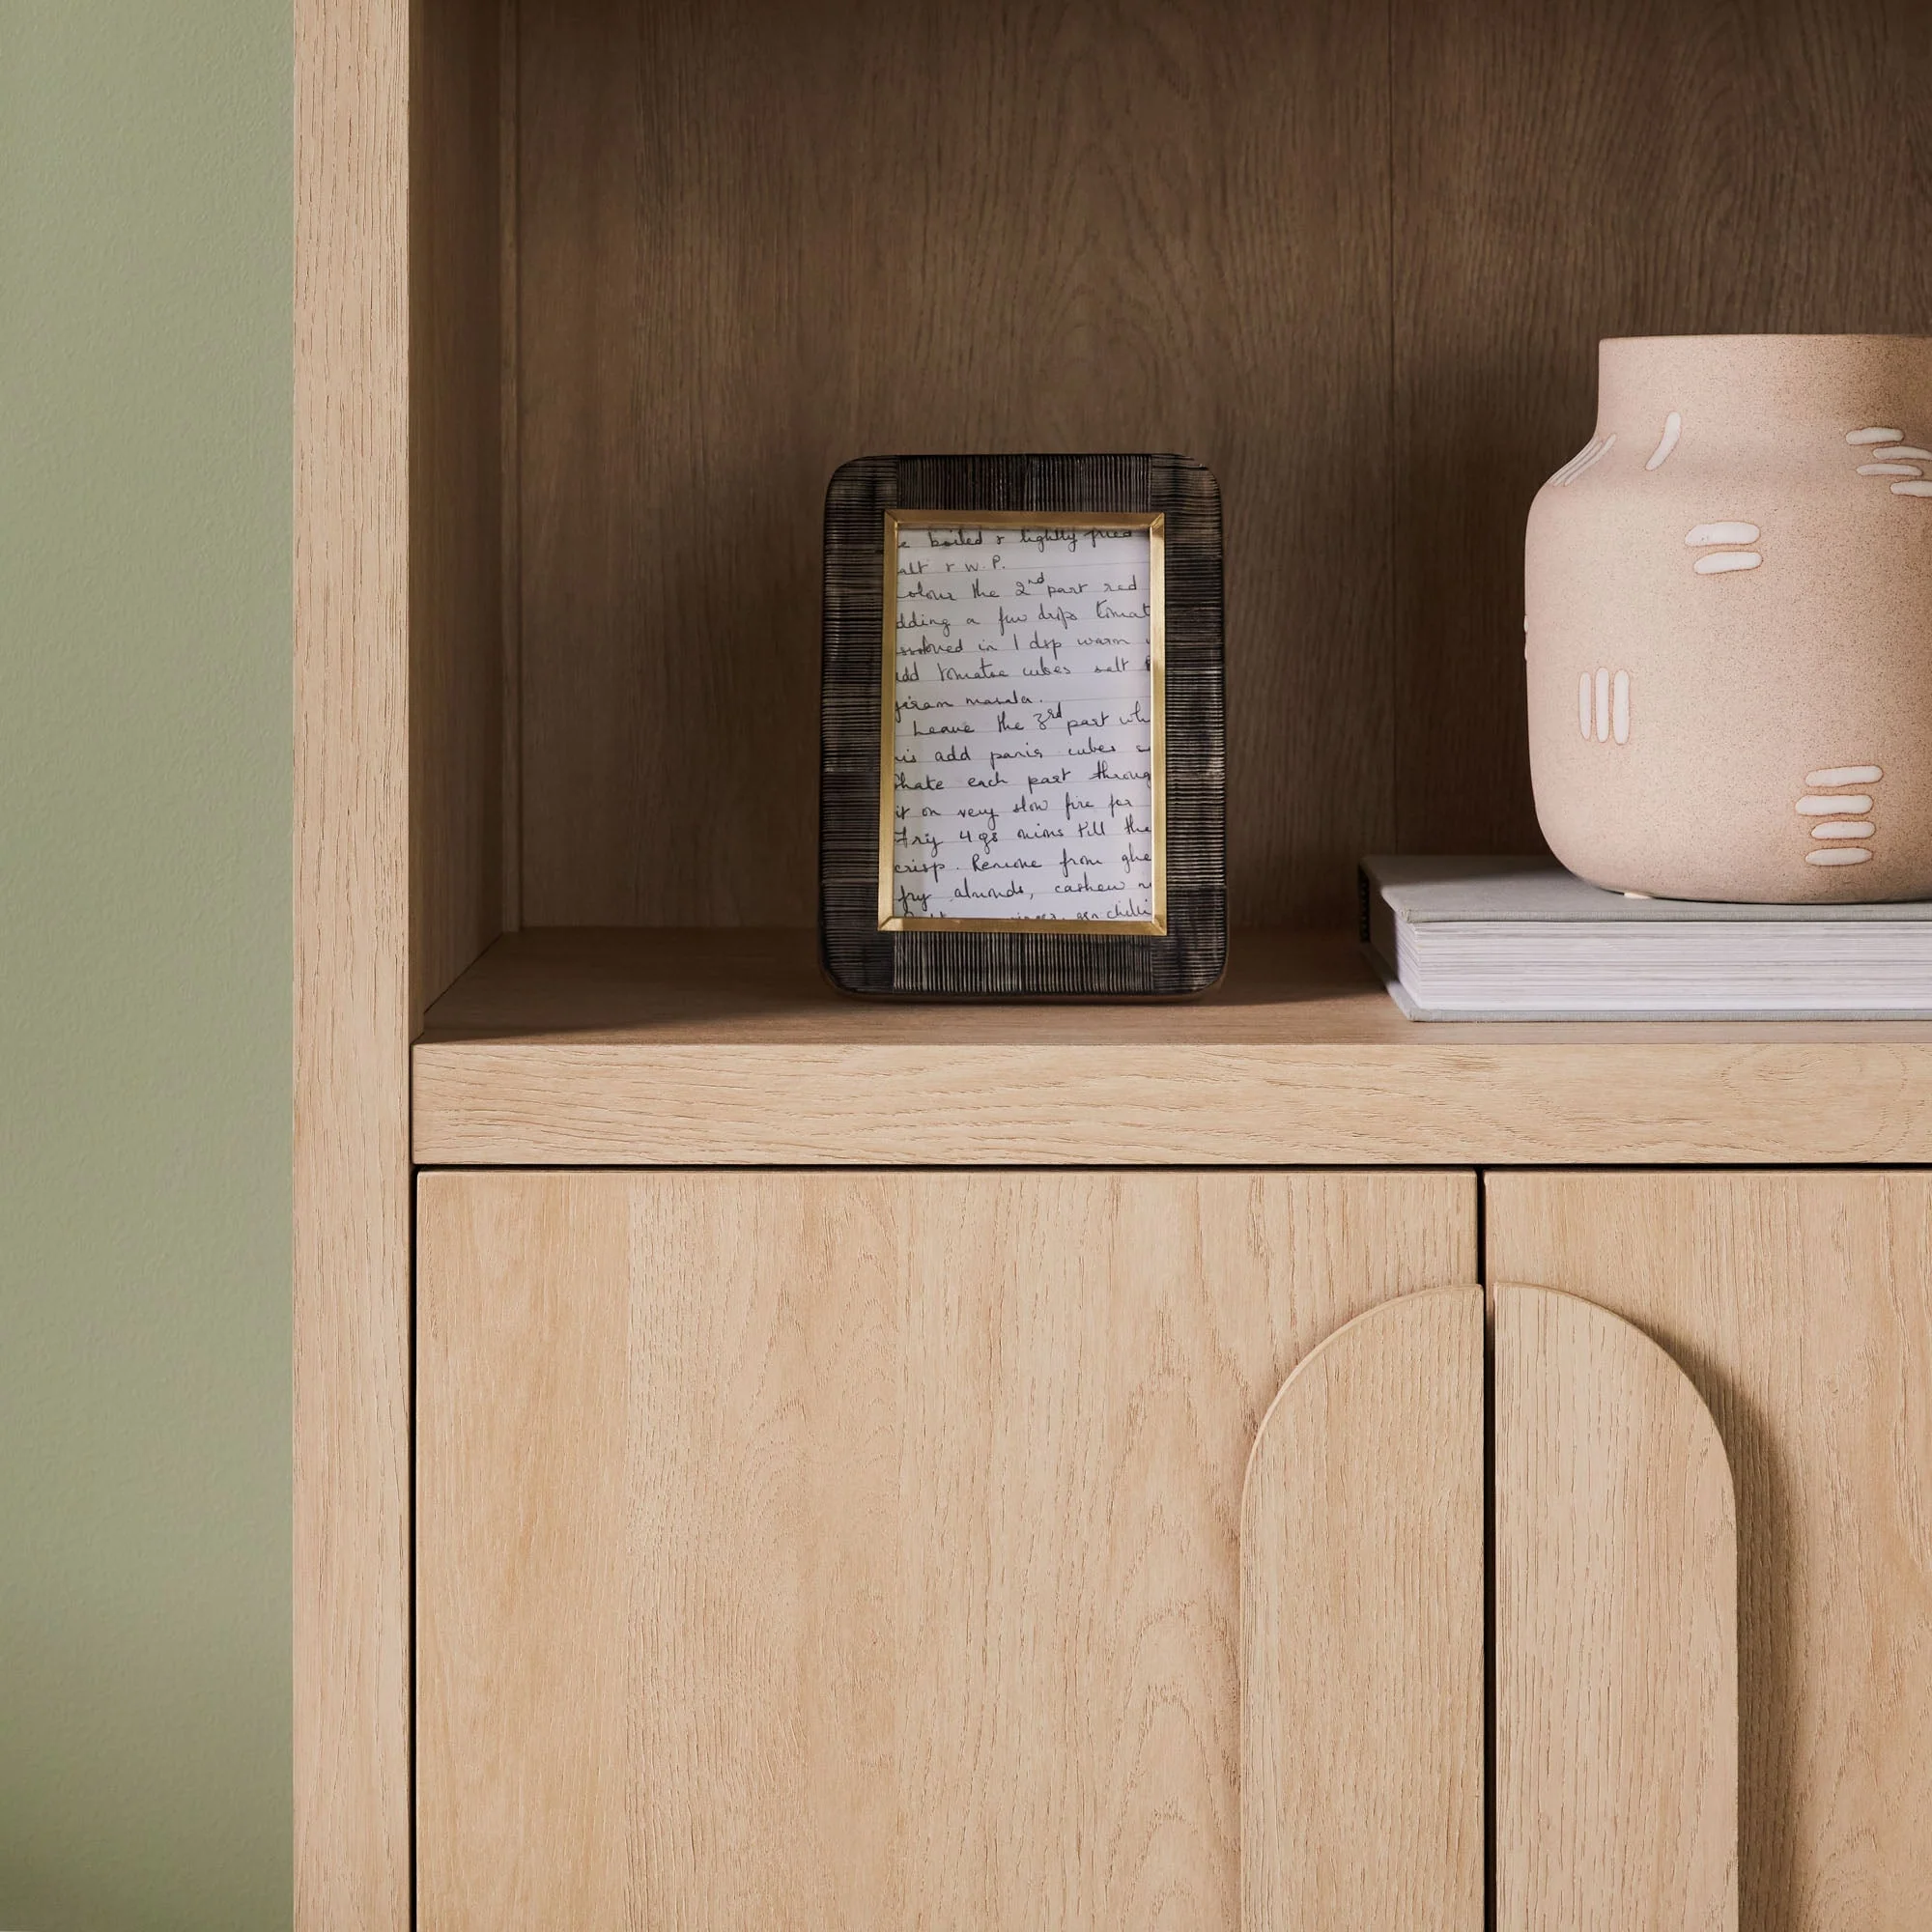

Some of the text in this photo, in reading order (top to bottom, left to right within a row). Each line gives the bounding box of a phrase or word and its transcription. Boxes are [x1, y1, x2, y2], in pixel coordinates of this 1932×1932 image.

[973, 579, 1000, 598] the
[1047, 583, 1088, 599] part
[1103, 575, 1138, 591] red
[998, 607, 1028, 637] few
[979, 639, 998, 651] in
[997, 711, 1024, 732] the
[1066, 712, 1110, 735] part
[935, 745, 971, 761] add
[967, 772, 1009, 787] each
[1028, 768, 1071, 794] part
[922, 805, 941, 817] on
[957, 806, 999, 831] very
[1012, 795, 1049, 813] slow
[1065, 792, 1094, 820] fire
[973, 854, 1042, 872] Remove
[1062, 848, 1103, 877] from
[897, 885, 932, 913] fry
[1054, 871, 1125, 894] cashew
